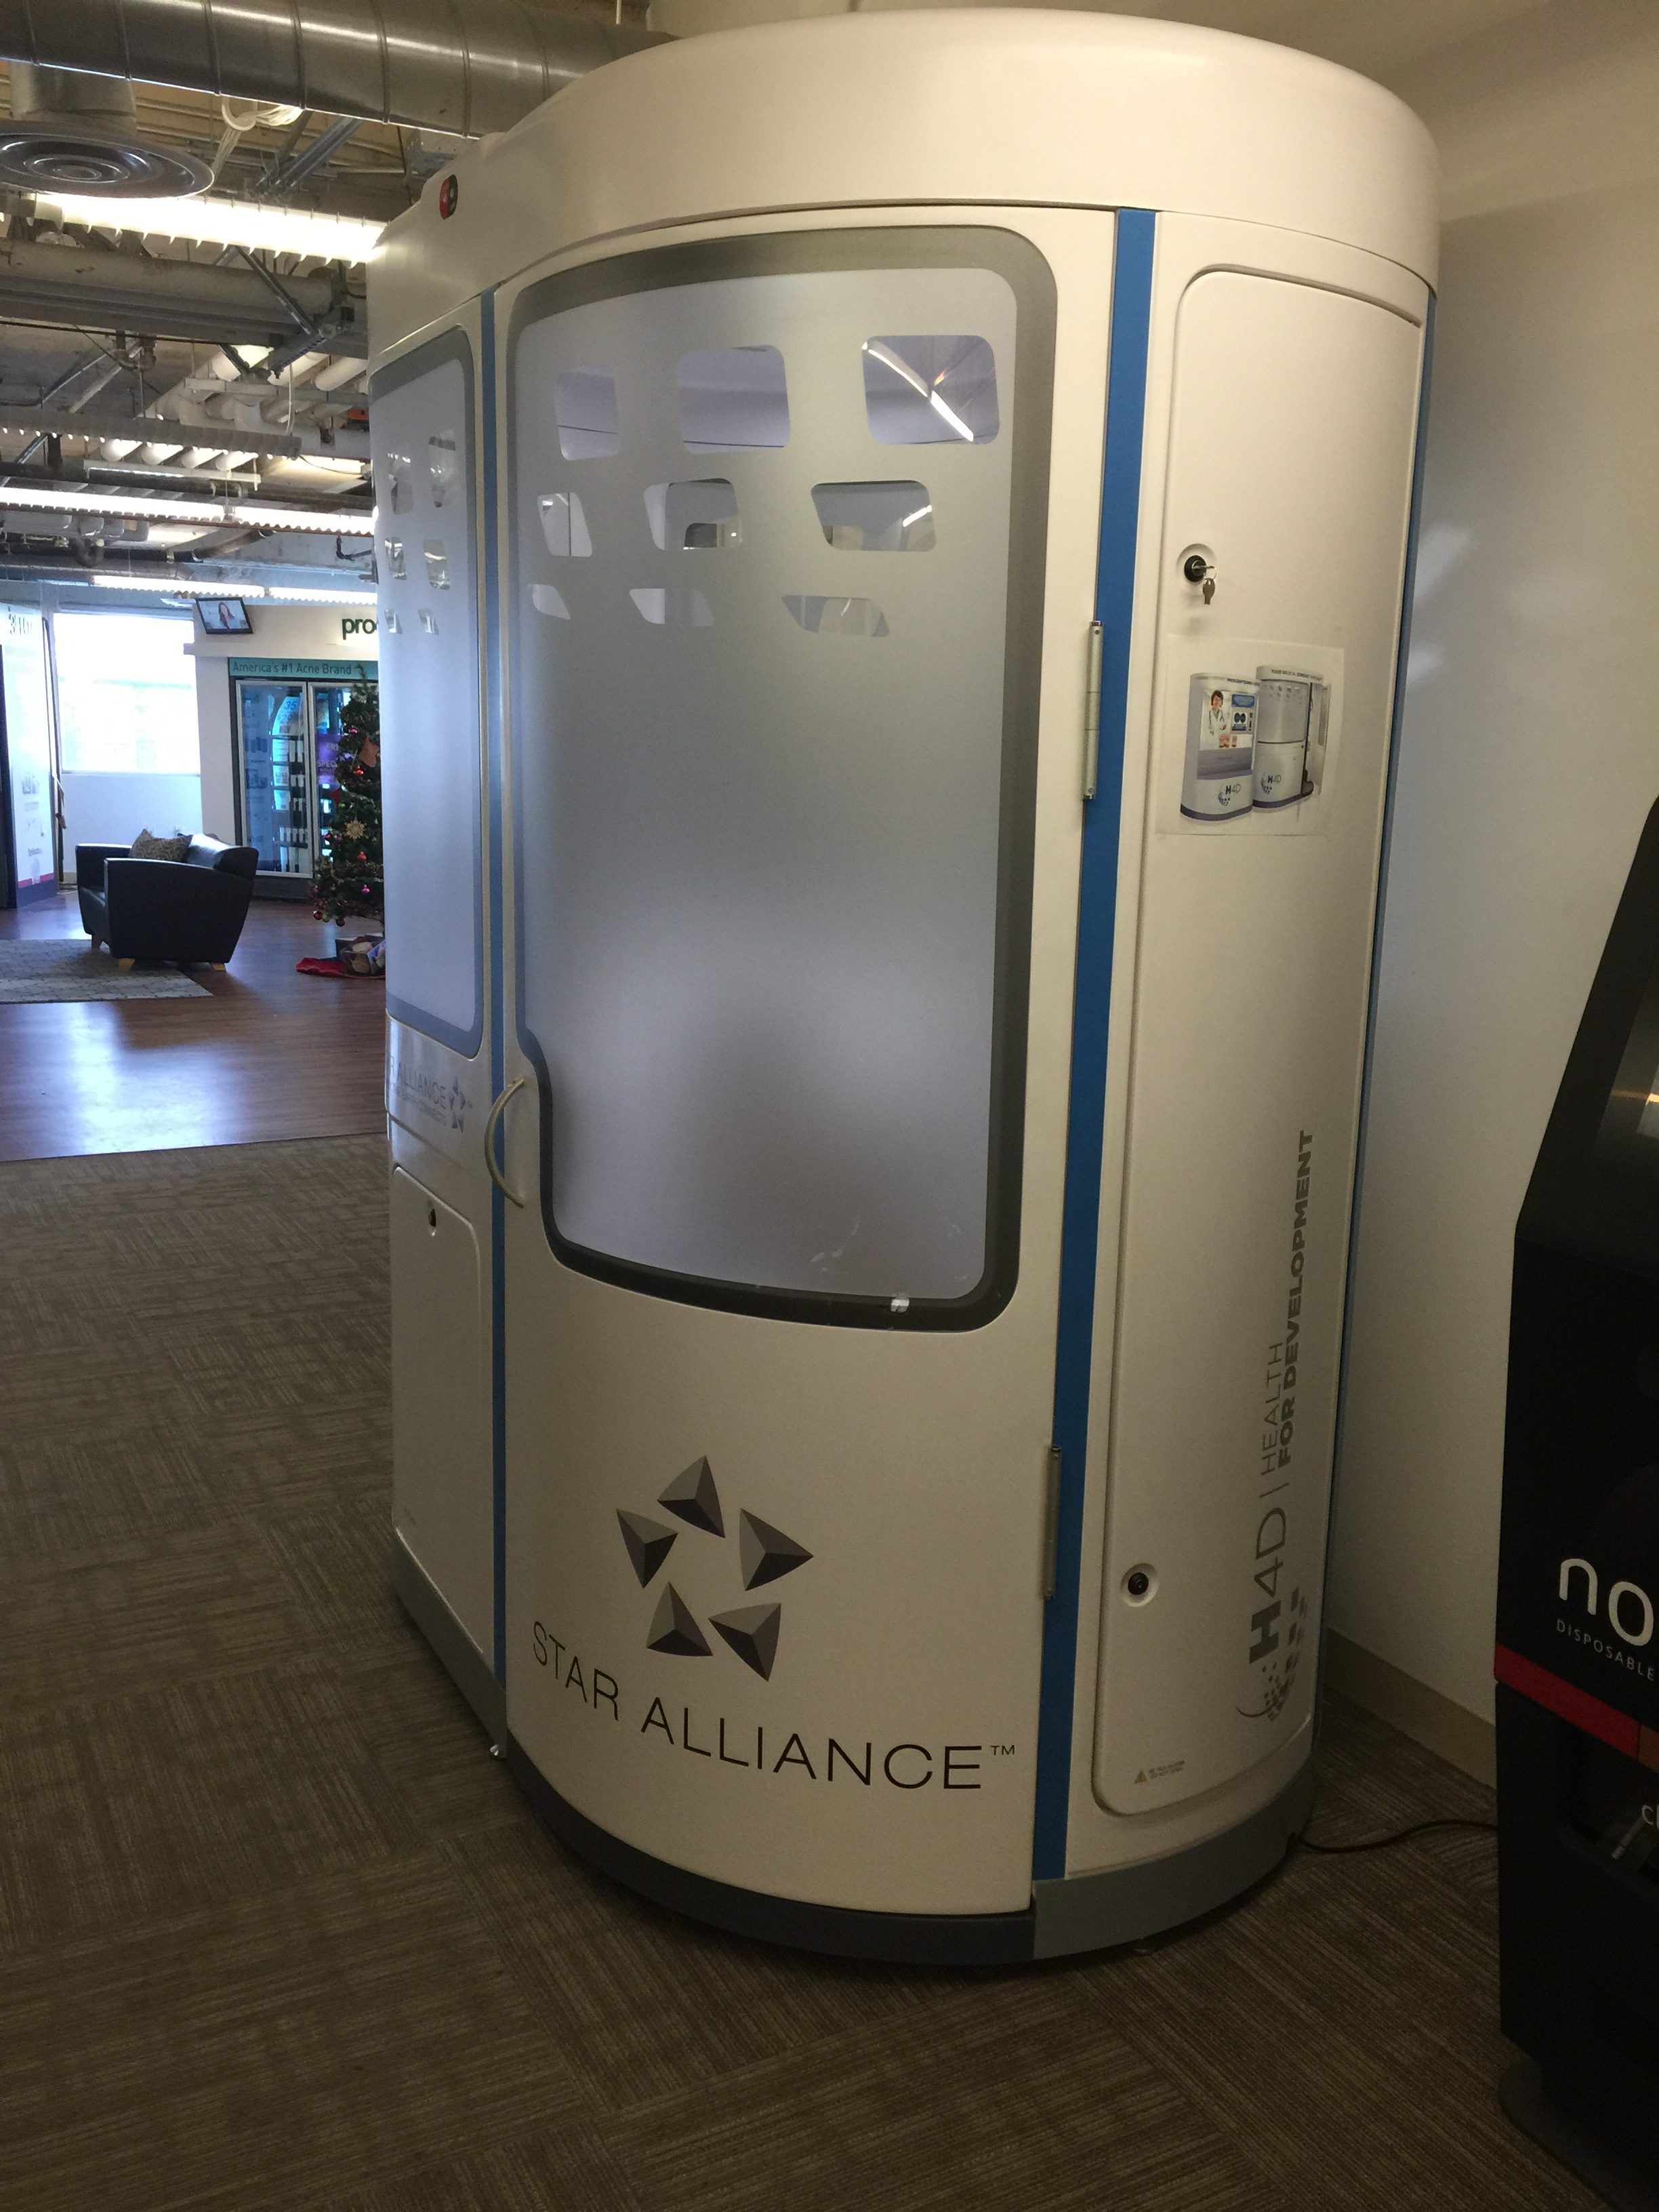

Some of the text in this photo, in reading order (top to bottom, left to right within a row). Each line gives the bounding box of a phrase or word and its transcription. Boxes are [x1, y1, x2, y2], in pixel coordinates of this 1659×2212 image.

[342, 618, 377, 640] pro
[232, 661, 352, 675] America's #1 Acne Brand
[1225, 783, 1241, 794] H4D
[1268, 775, 1282, 783] H4D
[397, 1062, 447, 1110] ALLIANCE
[1277, 1130, 1315, 1468] FOR DEVELOPMENT
[1249, 1341, 1286, 1664] H4D HEALTH
[533, 1620, 619, 1721] STAR
[1557, 1618, 1655, 1682] DISPOSABLE
